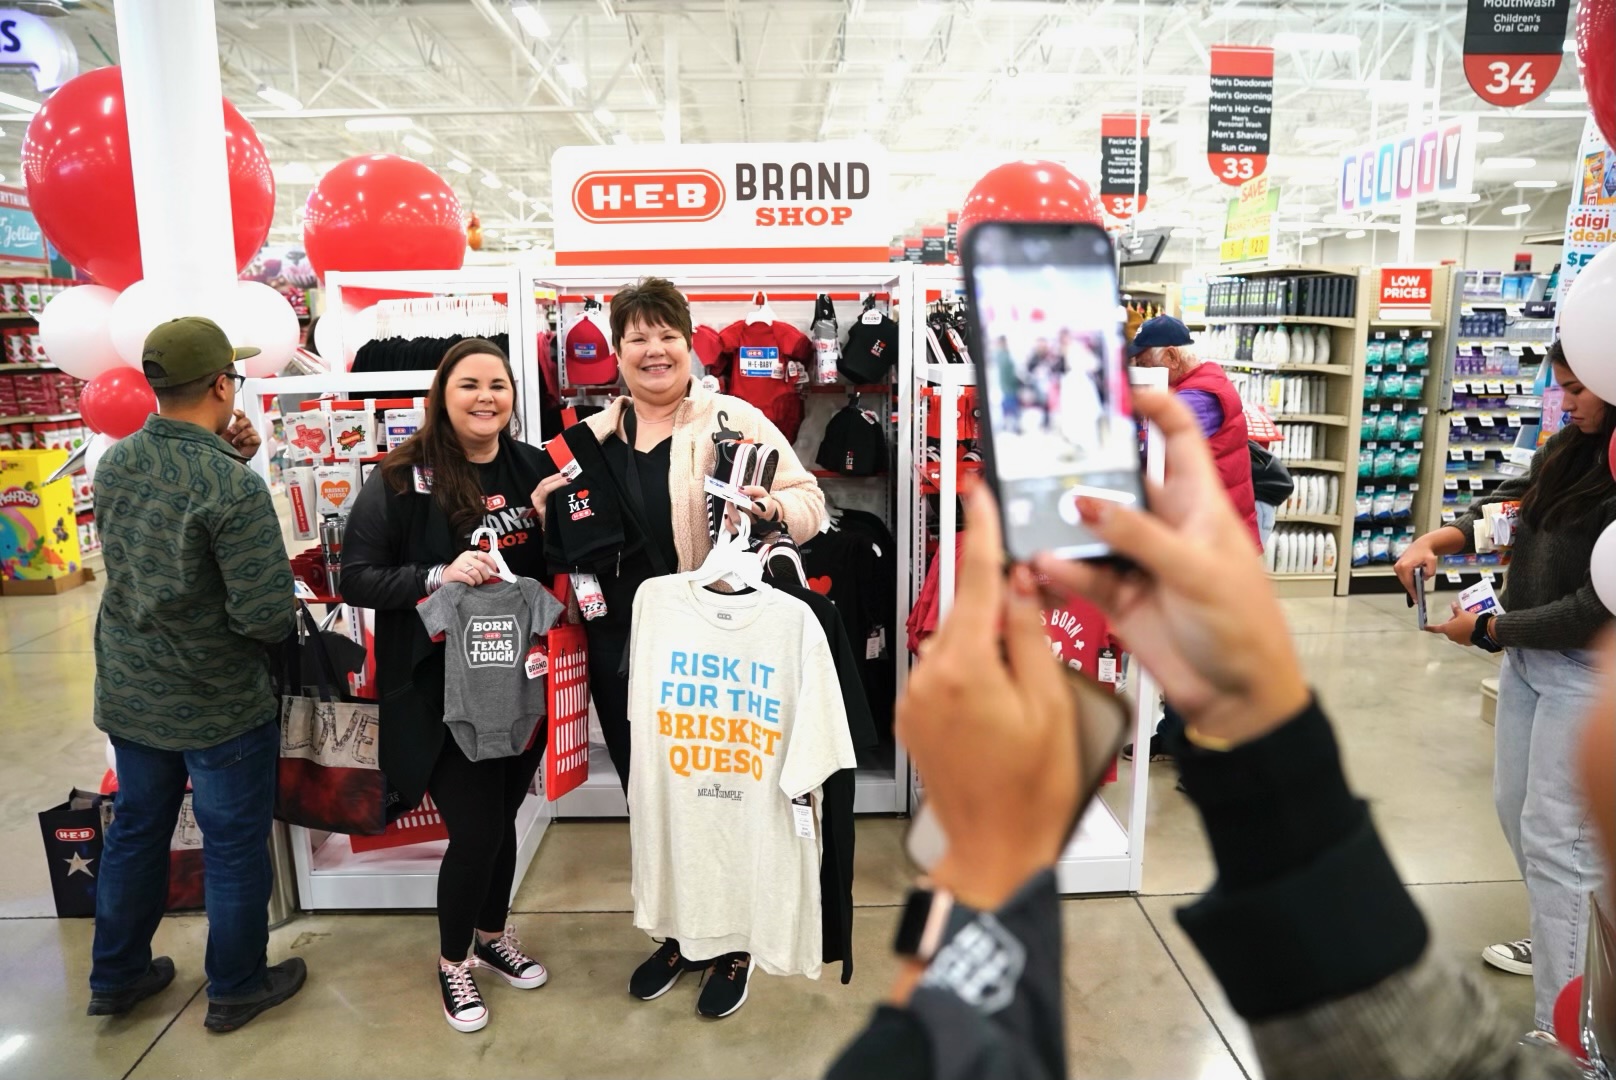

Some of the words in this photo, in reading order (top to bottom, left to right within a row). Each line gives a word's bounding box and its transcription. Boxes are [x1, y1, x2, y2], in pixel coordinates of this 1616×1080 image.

[1483, 0, 1555, 8] Mouthwash
[1494, 13, 1541, 23] Children's
[1494, 23, 1514, 32] Oral
[1517, 23, 1539, 32] Care
[0, 20, 21, 52] S
[1211, 78, 1232, 86] Men's
[1234, 79, 1272, 87] Deodorant
[1485, 61, 1536, 94] 34
[1211, 91, 1232, 99] Men's
[1234, 92, 1272, 101] Grooming
[1210, 104, 1232, 112] Men's
[1235, 105, 1251, 113] Hair
[1253, 106, 1271, 114] Care
[1211, 130, 1234, 139] Men's
[1236, 131, 1268, 141] Shaving
[1221, 144, 1236, 152] Sun
[1238, 144, 1257, 152] Care
[1222, 157, 1254, 179] 33
[736, 162, 869, 200] BRAND
[591, 183, 708, 210] H-E-B
[756, 207, 852, 226] SHOP
[1574, 214, 1609, 230] digi
[4, 225, 40, 248] Jollier
[1391, 276, 1420, 286] LOW
[1384, 288, 1427, 299] PRICES
[568, 493, 576, 503] I
[569, 499, 589, 513] MY
[479, 532, 528, 551] SOP
[472, 621, 513, 632] BORN
[1051, 609, 1083, 638] BORN
[471, 640, 512, 651] TEXAS
[470, 650, 514, 662] TOUGH
[528, 661, 547, 672] BRAND
[670, 651, 741, 682] RISK
[751, 661, 775, 689] IT
[660, 680, 719, 709] FOR
[727, 688, 781, 724] THE
[657, 709, 782, 757] BRISKET
[669, 745, 763, 782] QUESO
[697, 788, 715, 797] MEAL
[719, 790, 742, 799] SIMPLE
[60, 831, 90, 839] H-E-B
